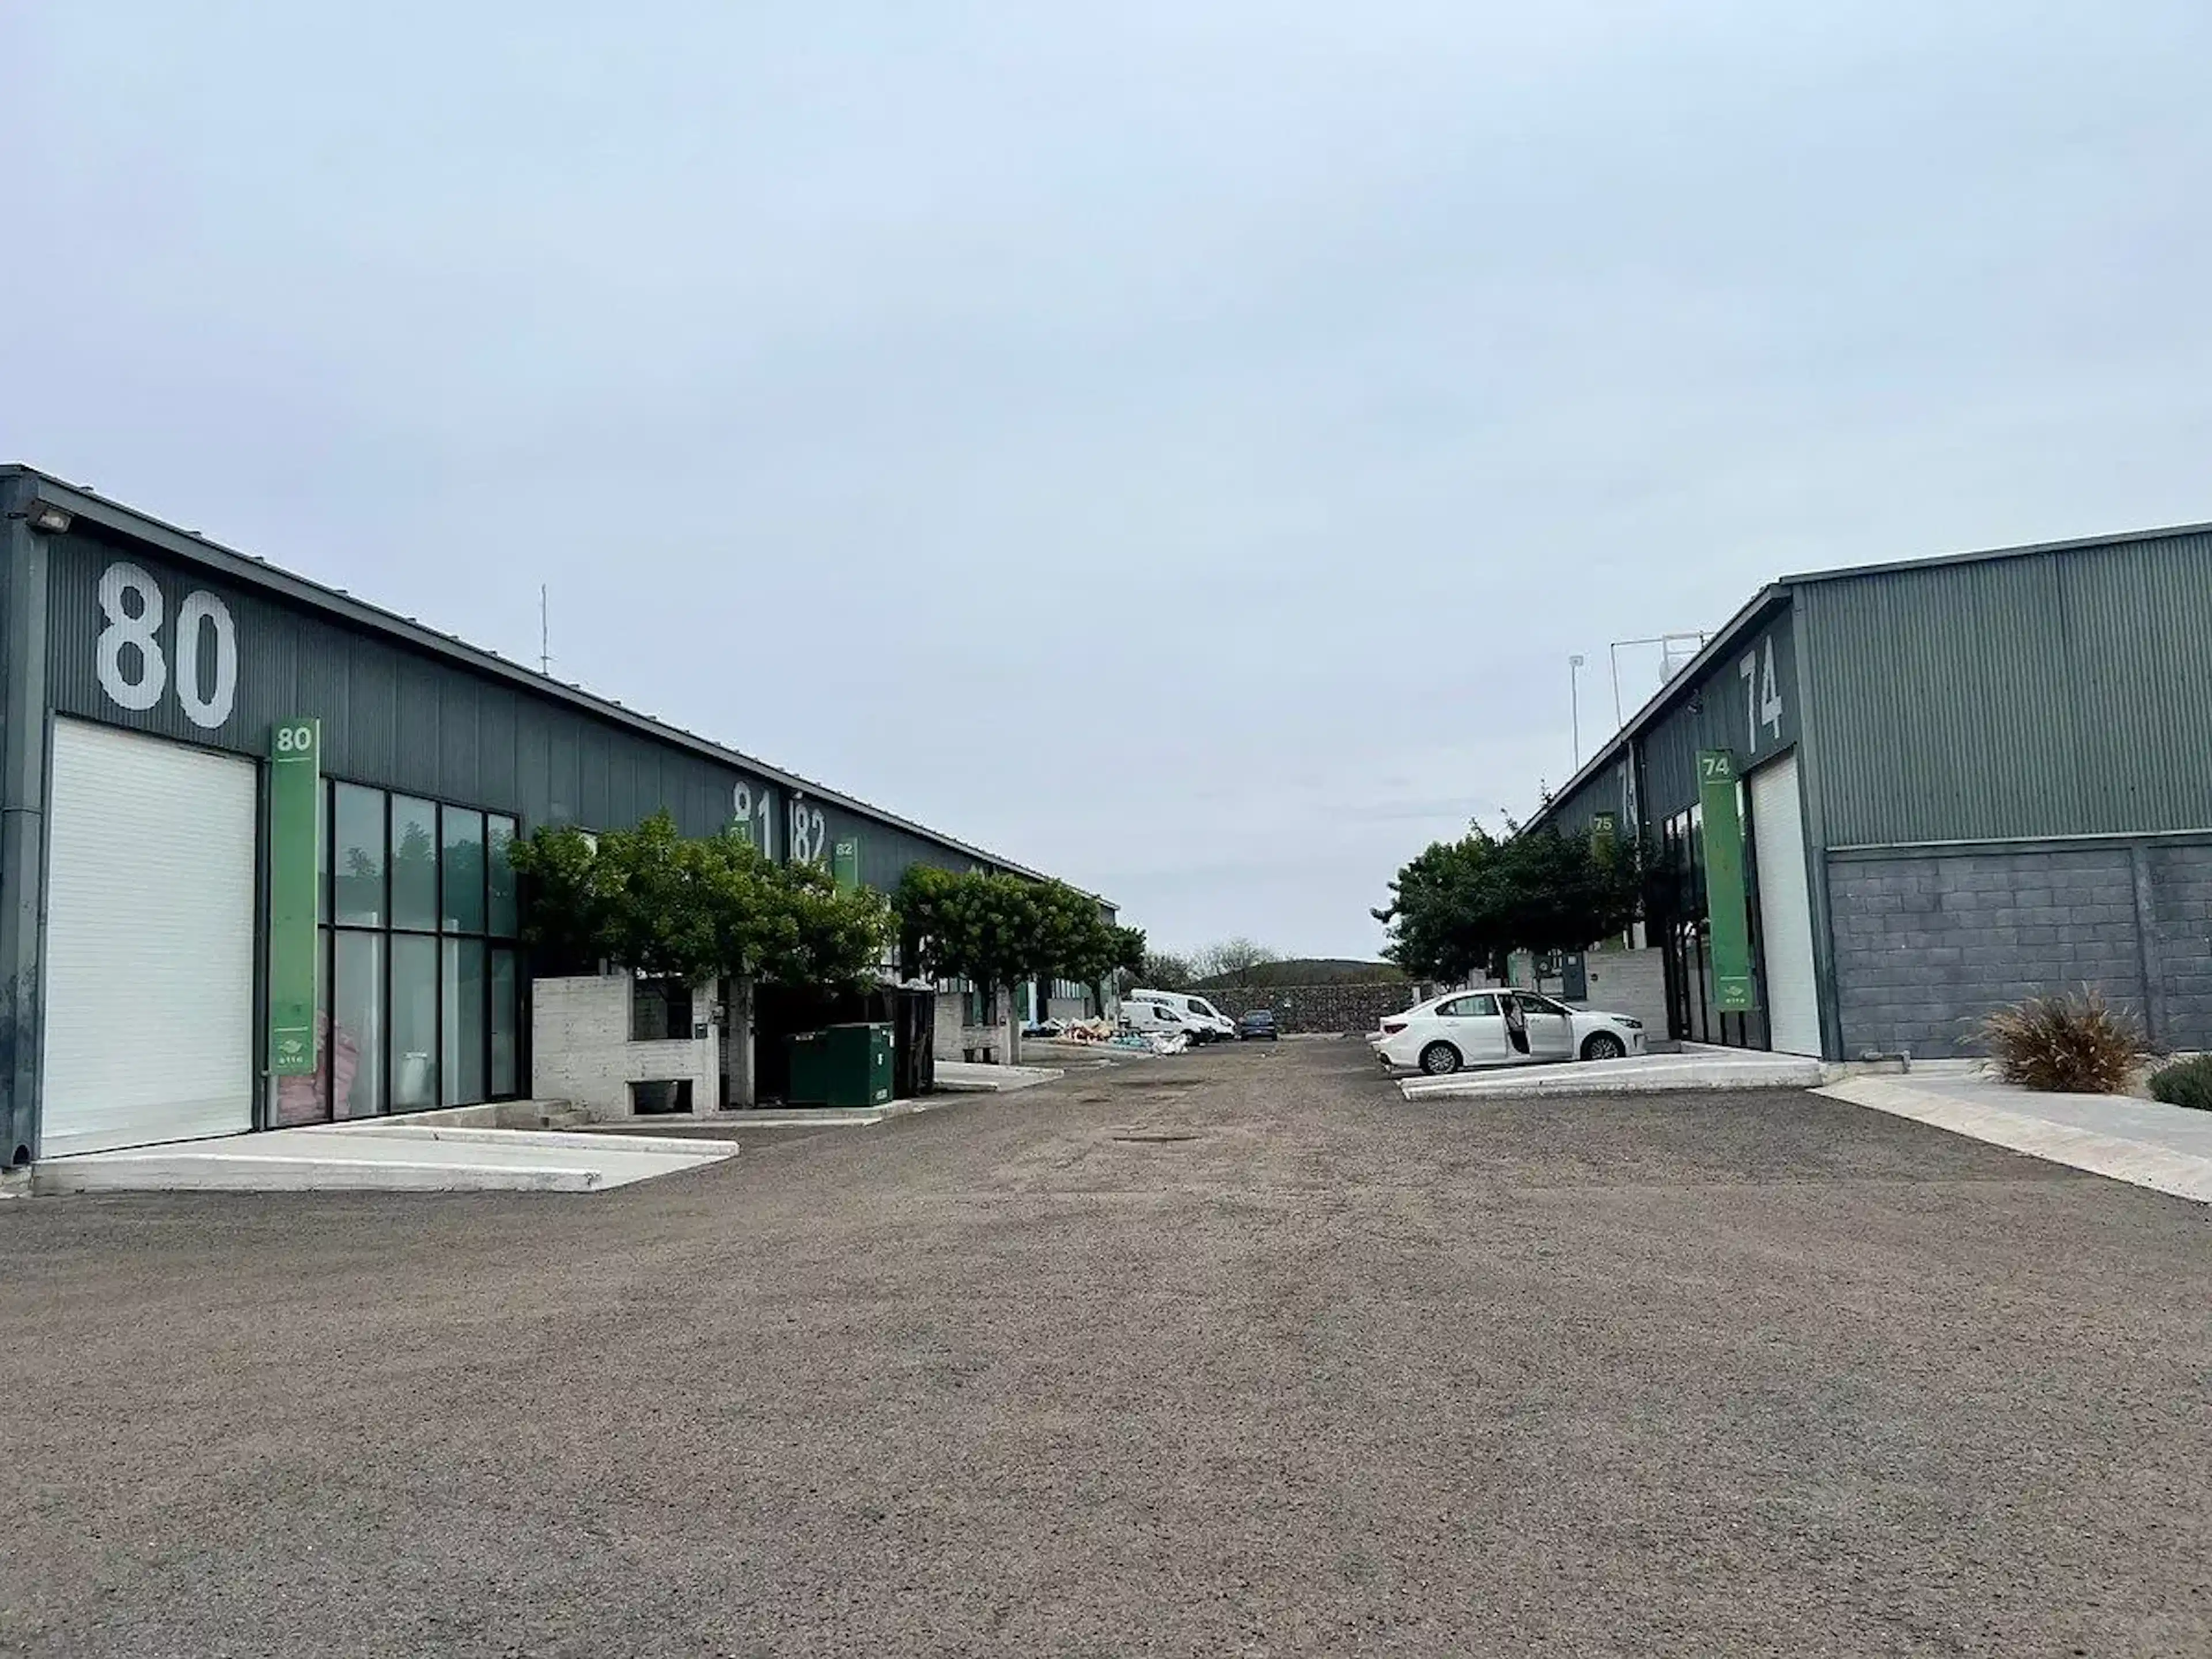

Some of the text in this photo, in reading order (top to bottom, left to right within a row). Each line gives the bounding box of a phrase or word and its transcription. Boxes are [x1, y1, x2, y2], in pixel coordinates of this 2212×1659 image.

[97, 561, 237, 729] 80
[1739, 634, 1782, 755] 74
[277, 727, 312, 751] 80
[1703, 757, 1730, 775] 74
[795, 804, 825, 866] 82
[1594, 817, 1612, 831] 75
[836, 843, 853, 855] 82
